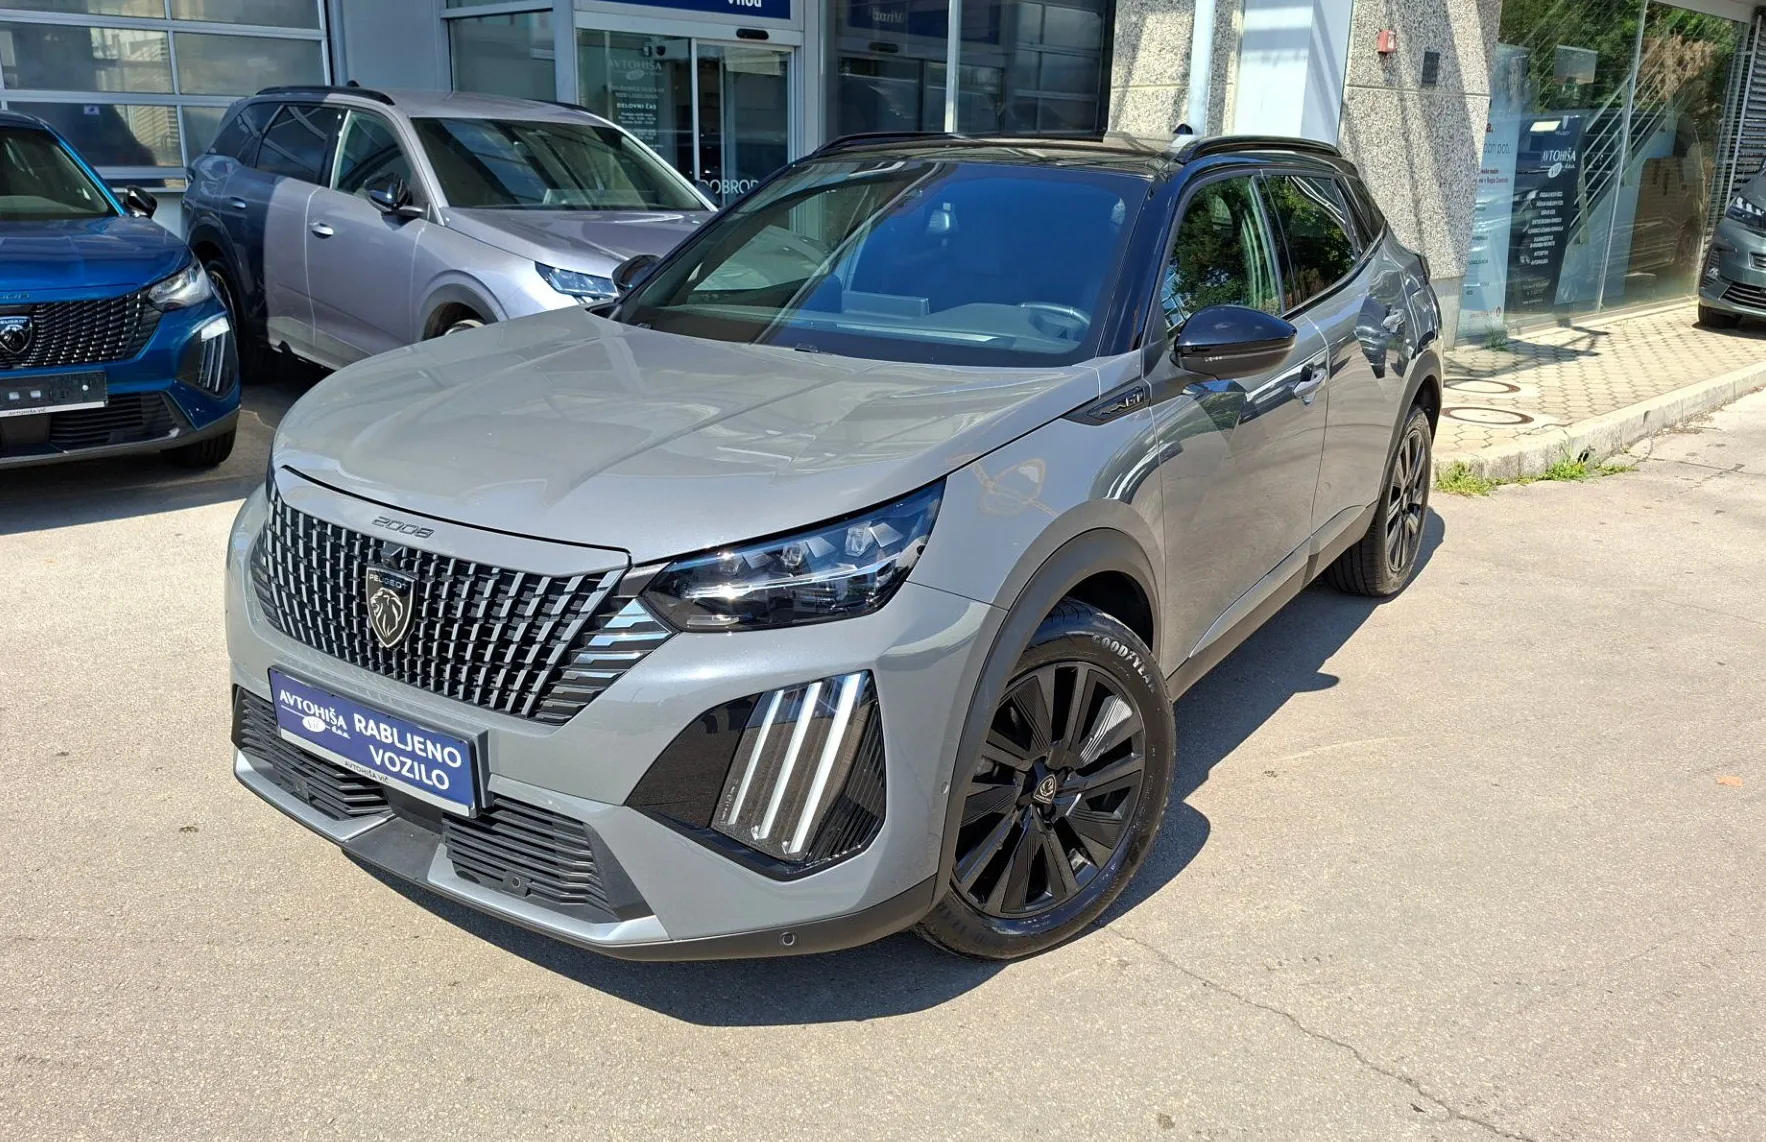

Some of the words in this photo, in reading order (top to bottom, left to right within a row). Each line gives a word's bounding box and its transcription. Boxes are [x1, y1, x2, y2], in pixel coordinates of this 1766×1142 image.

[371, 515, 435, 540] 2008
[368, 572, 408, 590] PEUGEOT
[279, 688, 348, 731] AVTOHIŠA
[353, 713, 463, 768] RABLJENO
[344, 760, 377, 779] AVTOHIŠA
[368, 744, 450, 790] VOZILO
